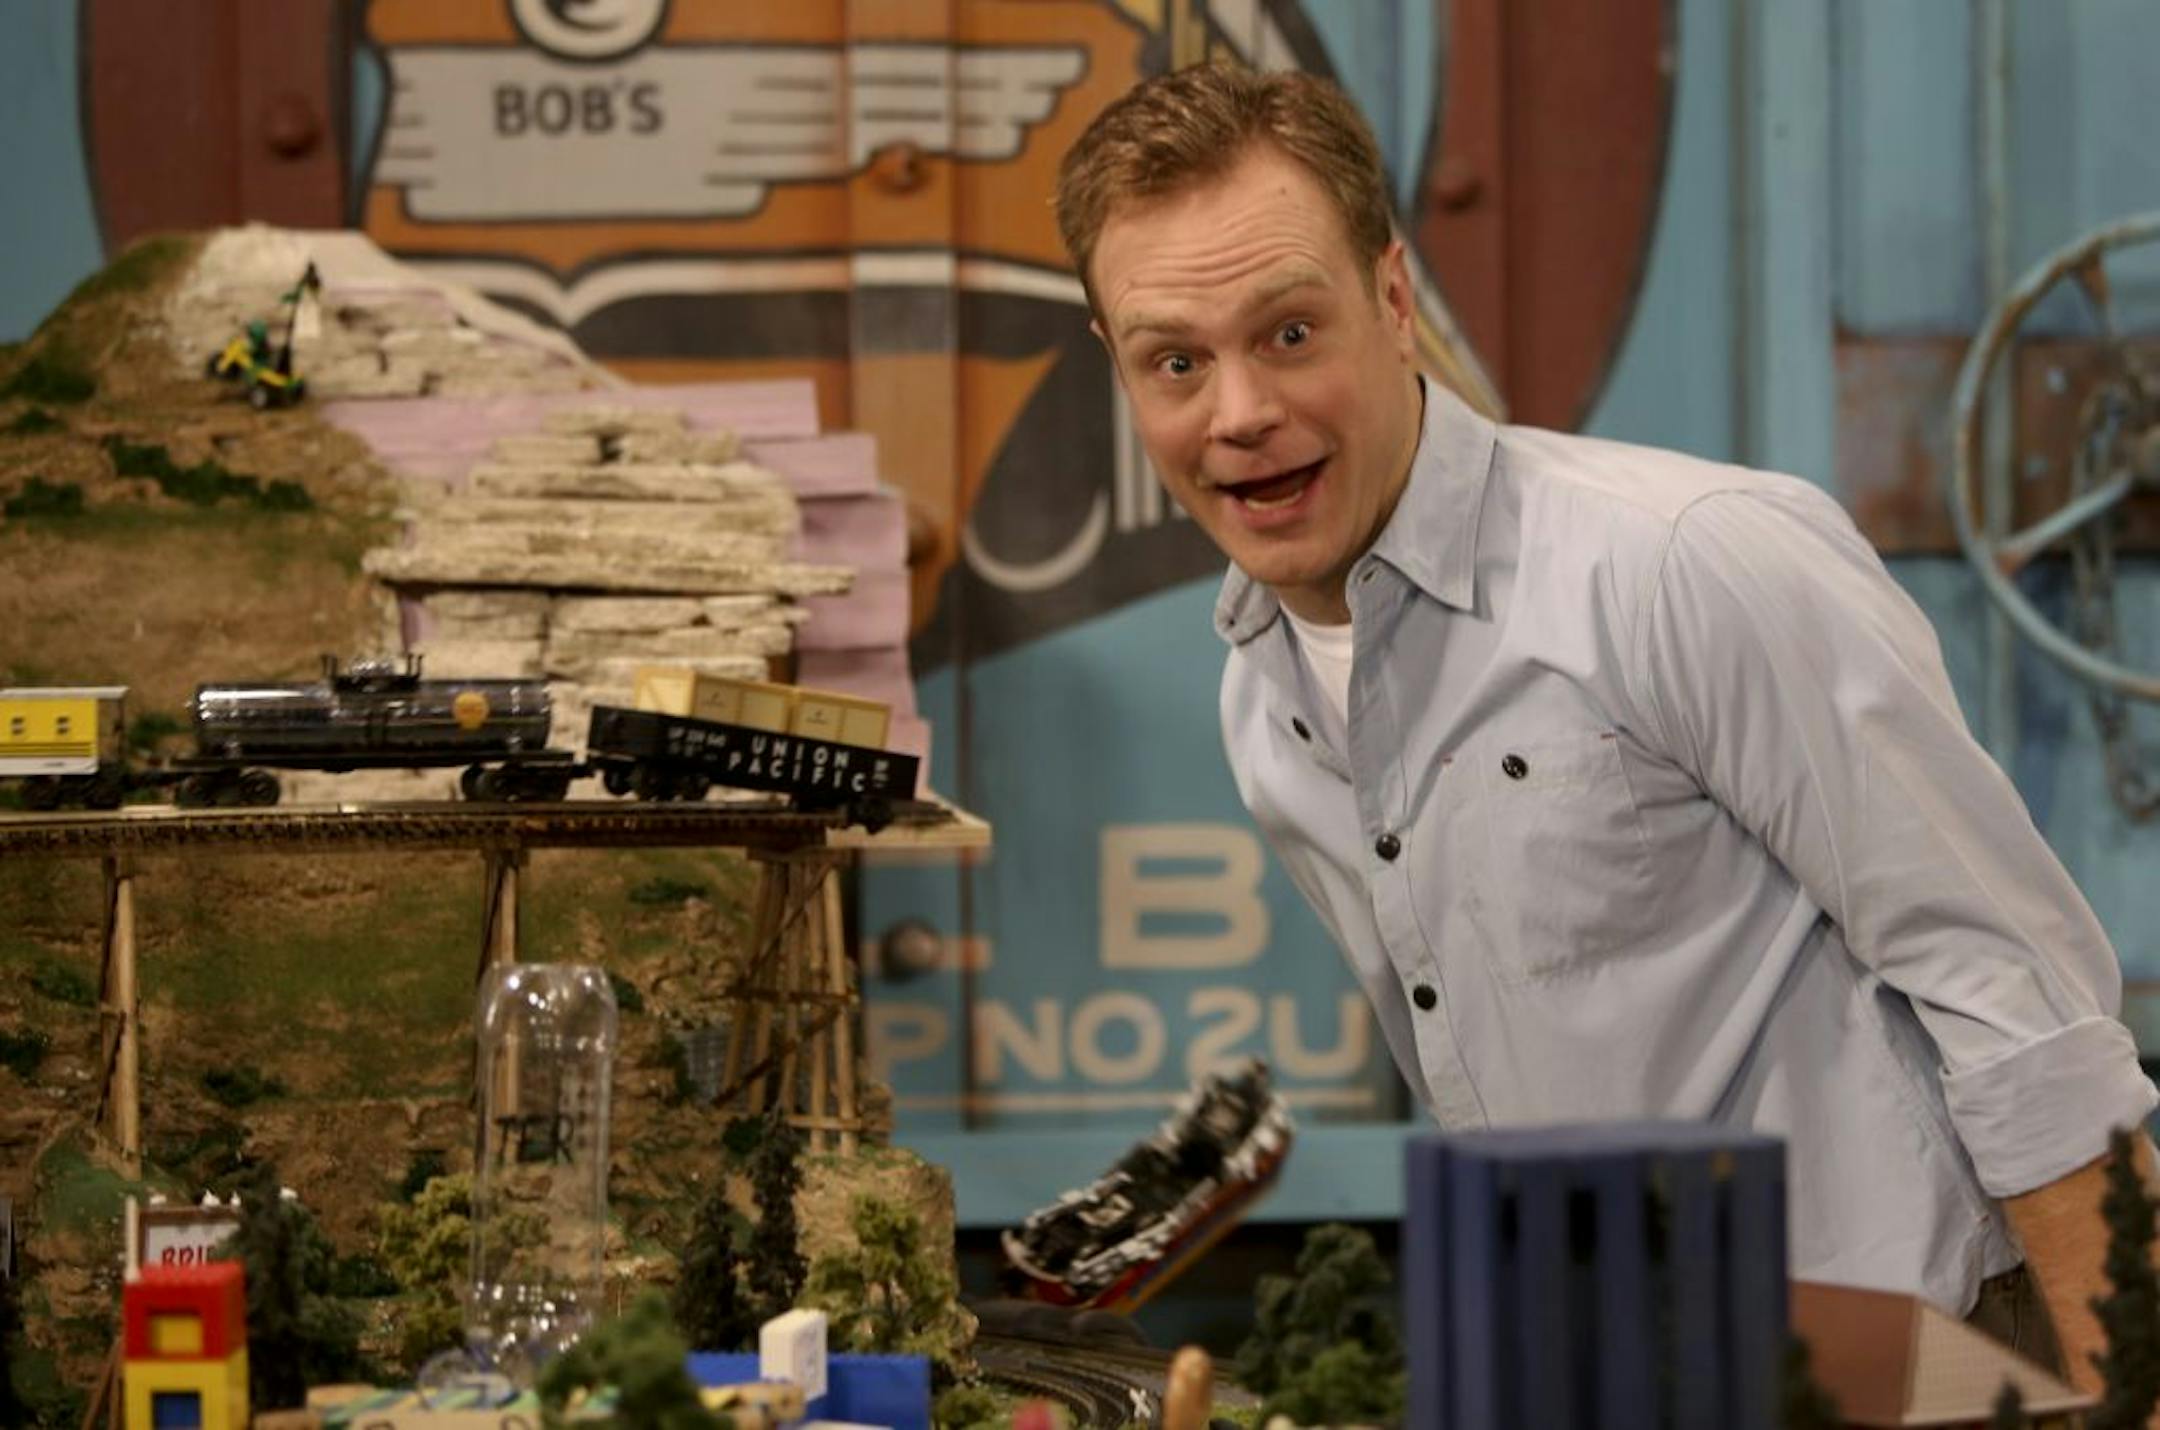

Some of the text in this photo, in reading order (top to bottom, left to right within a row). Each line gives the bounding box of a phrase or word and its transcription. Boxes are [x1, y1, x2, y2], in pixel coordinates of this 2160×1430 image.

[493, 76, 664, 136] BOB'S
[727, 751, 866, 792] PACIFIC
[750, 734, 849, 768] UNION
